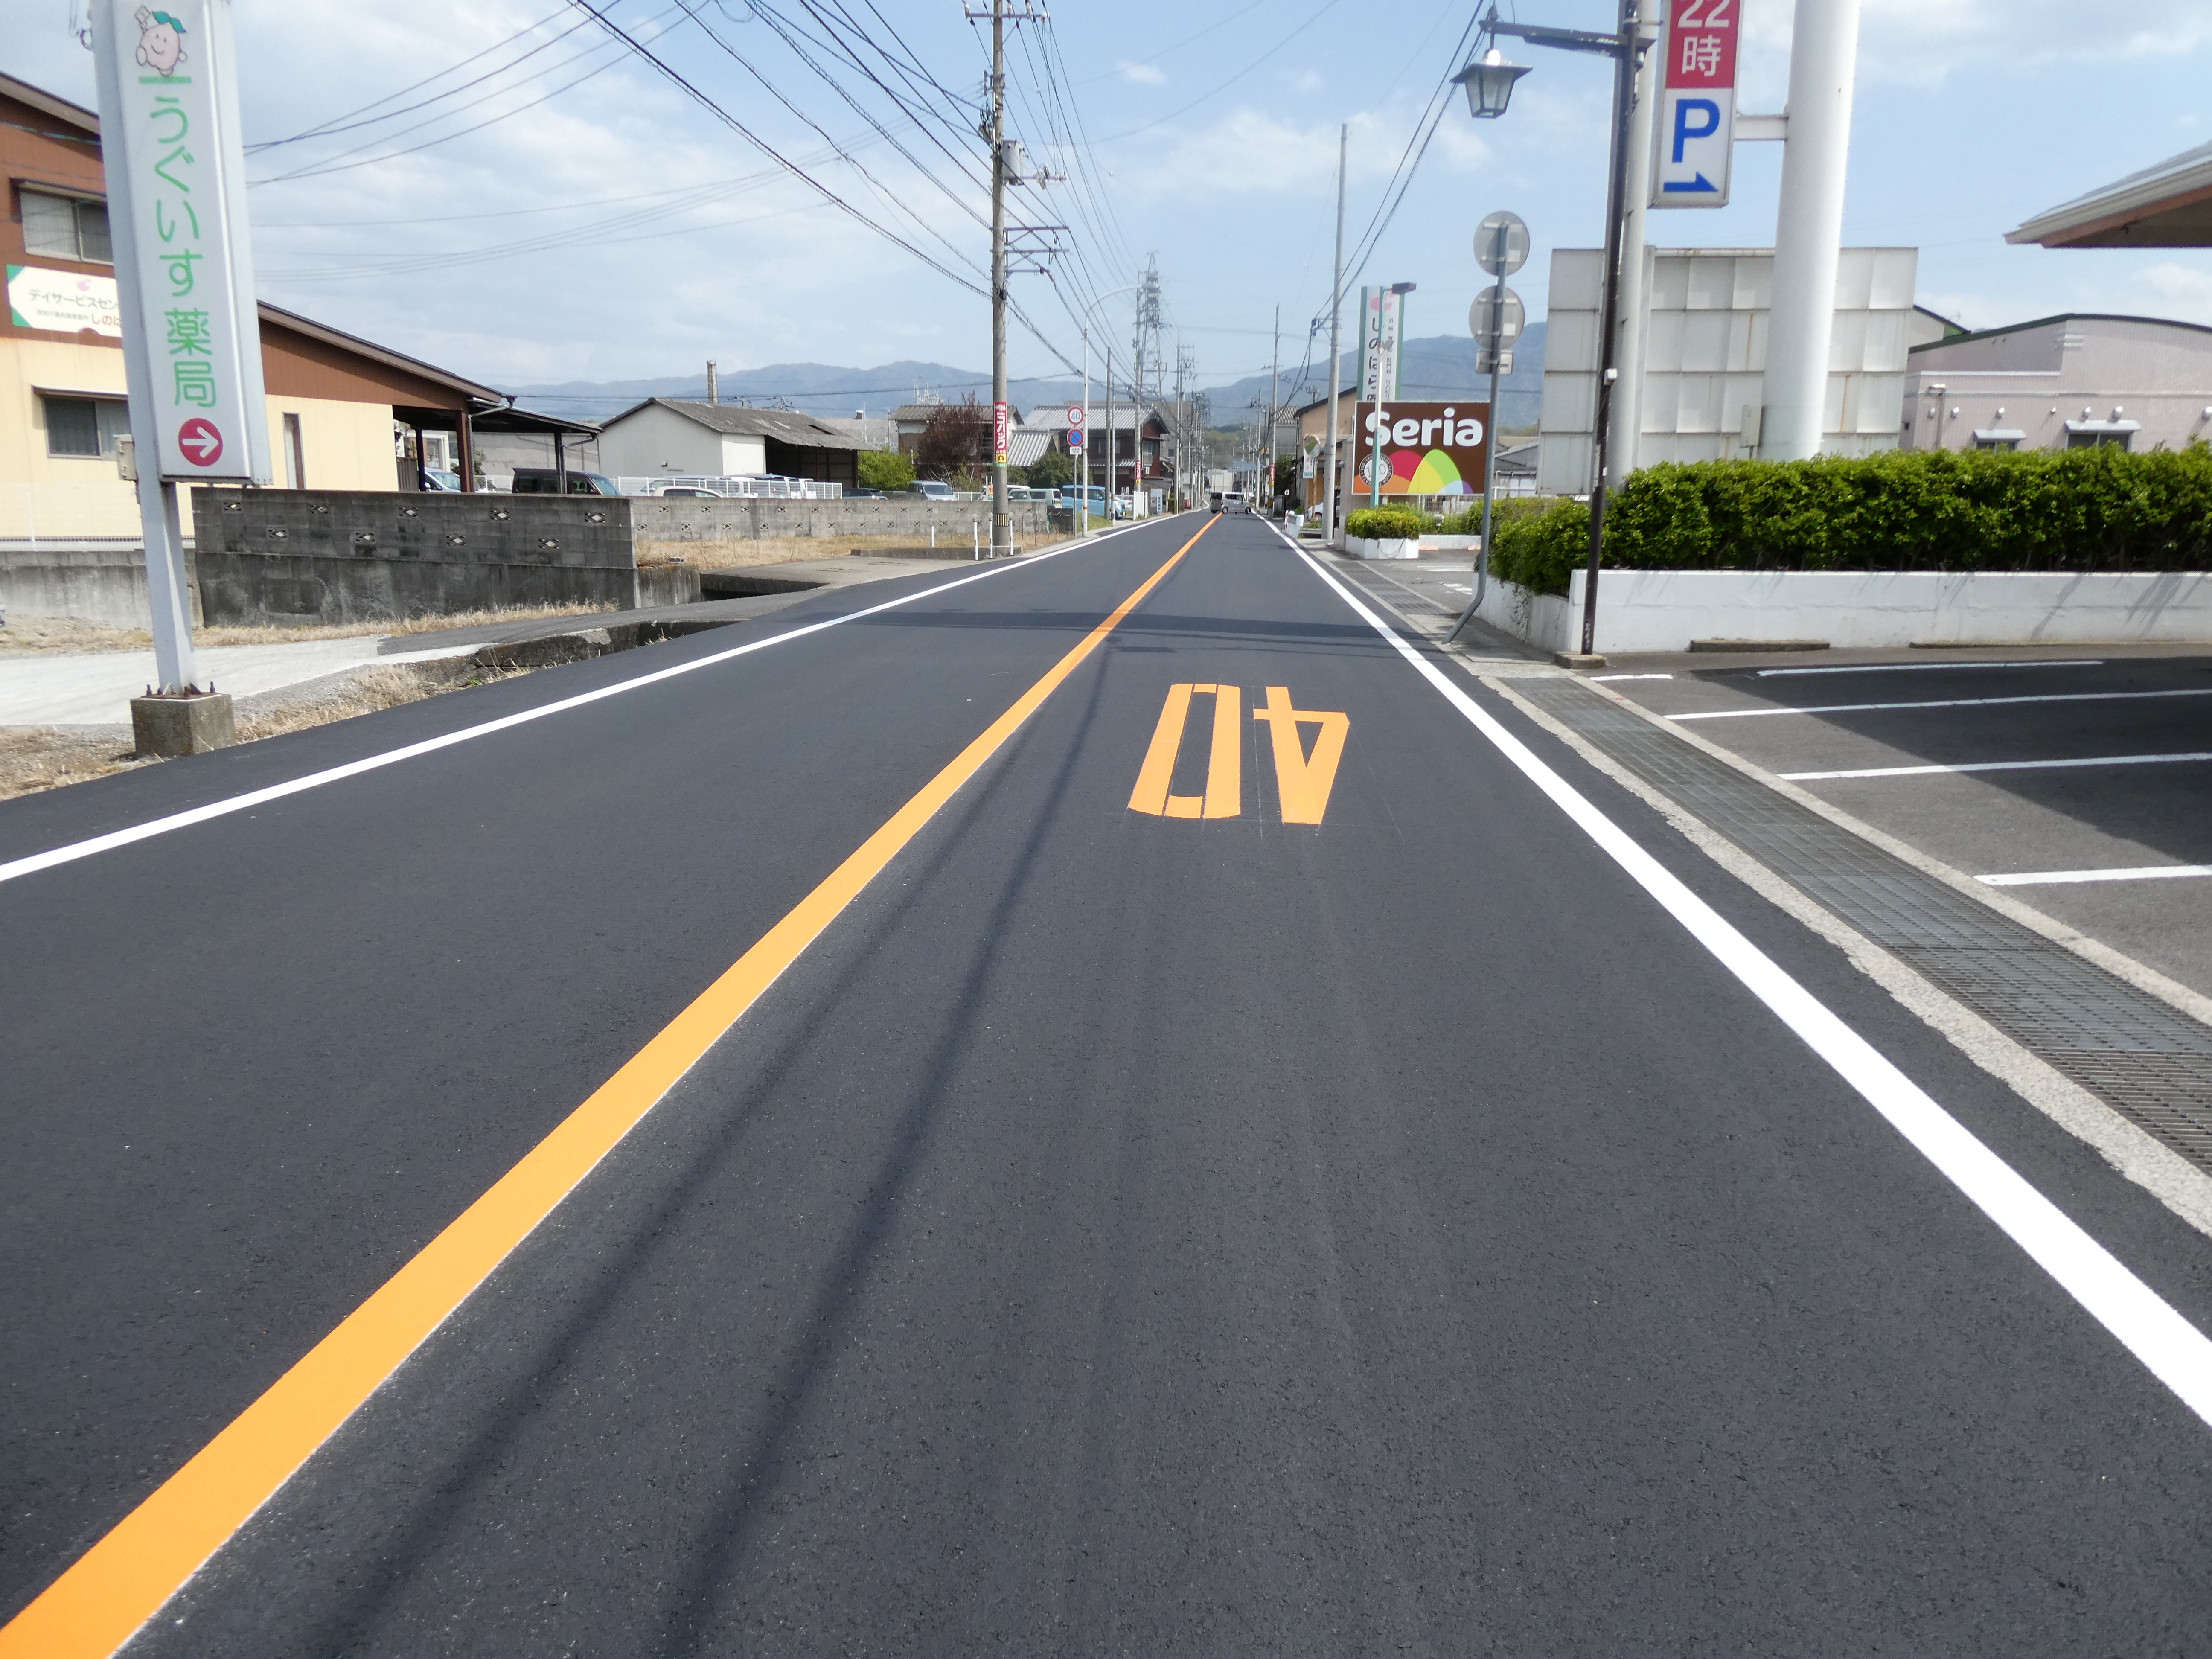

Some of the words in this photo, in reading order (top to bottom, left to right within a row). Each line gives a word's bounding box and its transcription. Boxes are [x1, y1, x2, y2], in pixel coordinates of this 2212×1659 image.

[1672, 99, 1720, 163] P
[150, 96, 216, 408] うぐいす薬局
[1071, 411, 1080, 419] 40
[1365, 407, 1483, 446] Seria
[1366, 464, 1386, 477] 10
[1128, 684, 1350, 824] 40
